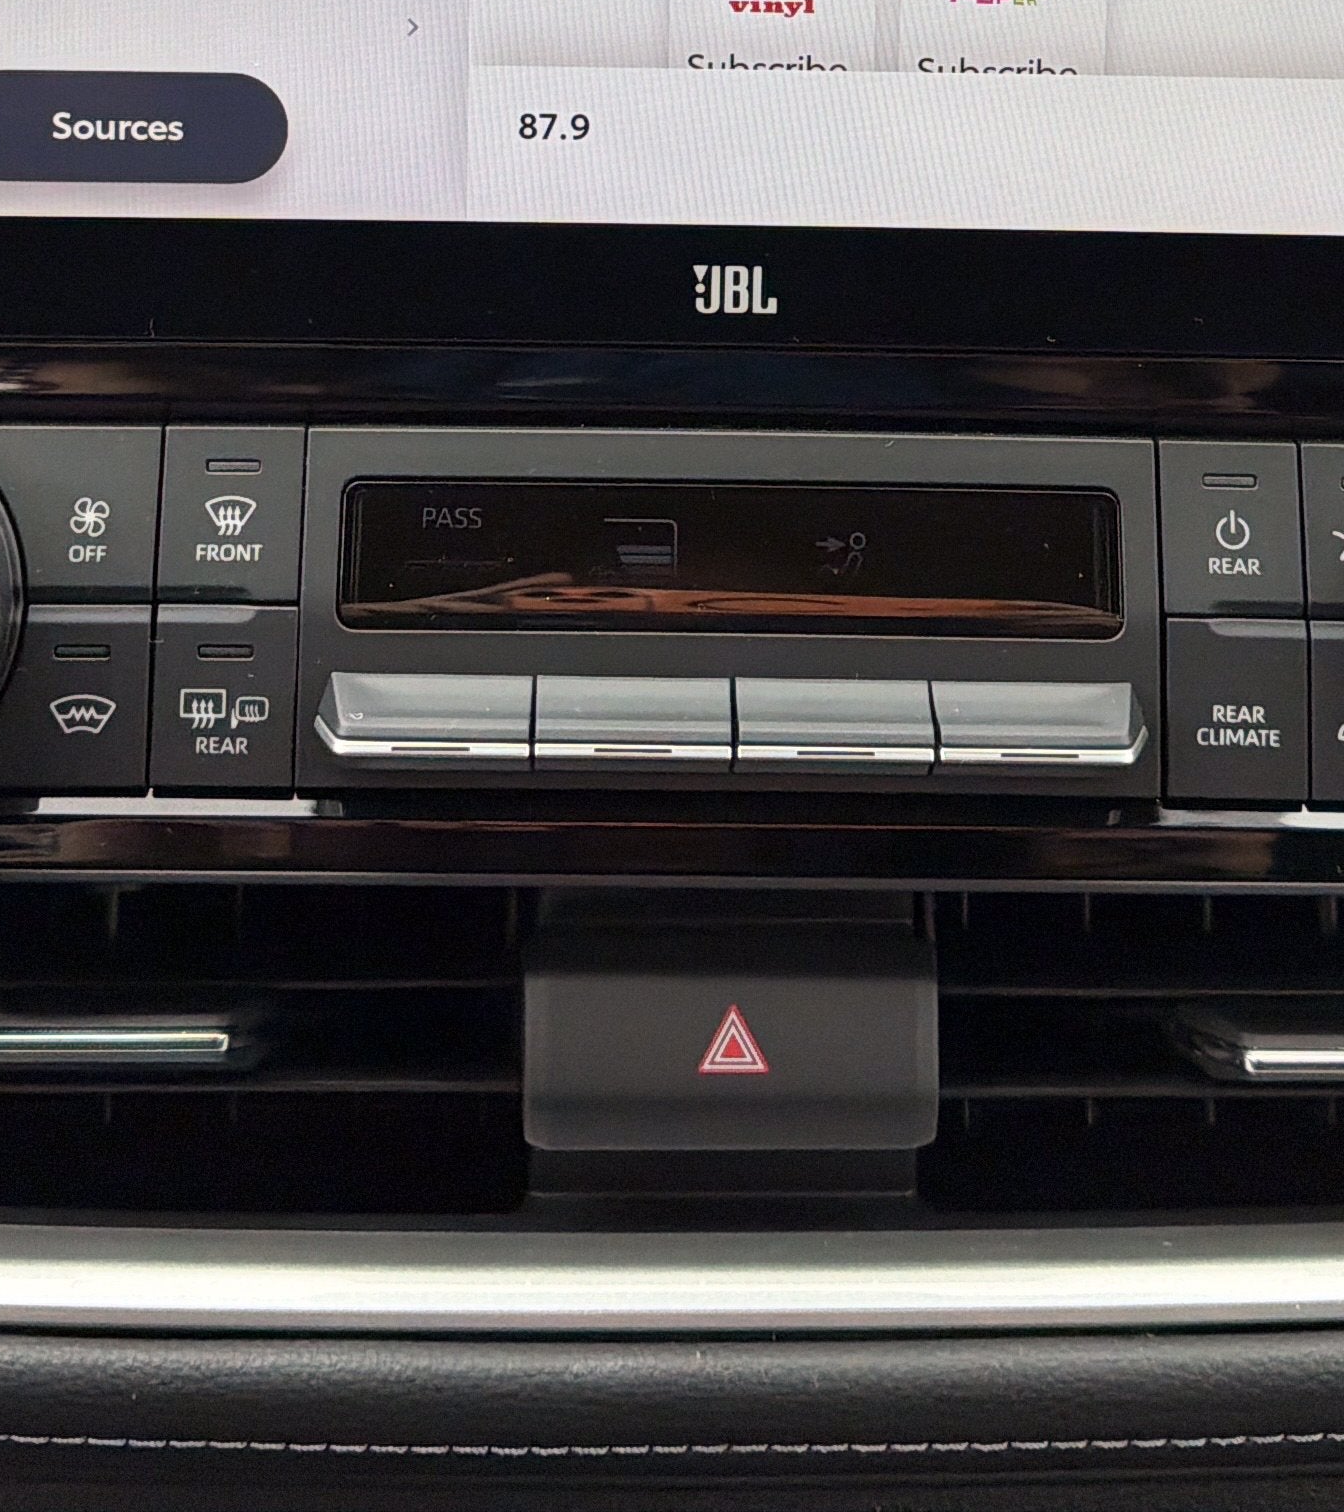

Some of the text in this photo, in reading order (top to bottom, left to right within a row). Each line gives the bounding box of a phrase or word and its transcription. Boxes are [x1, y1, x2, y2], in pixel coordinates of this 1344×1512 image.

[53, 112, 183, 140] Sources
[519, 114, 589, 140] 87.9
[693, 265, 777, 313] JBL
[423, 508, 481, 528] PASS
[69, 545, 106, 562] OFF
[196, 544, 263, 561] FRONT
[1209, 558, 1261, 575] REAR
[1213, 705, 1265, 723] REAR
[196, 737, 248, 754] REAR
[1197, 728, 1280, 747] CLIMATE
